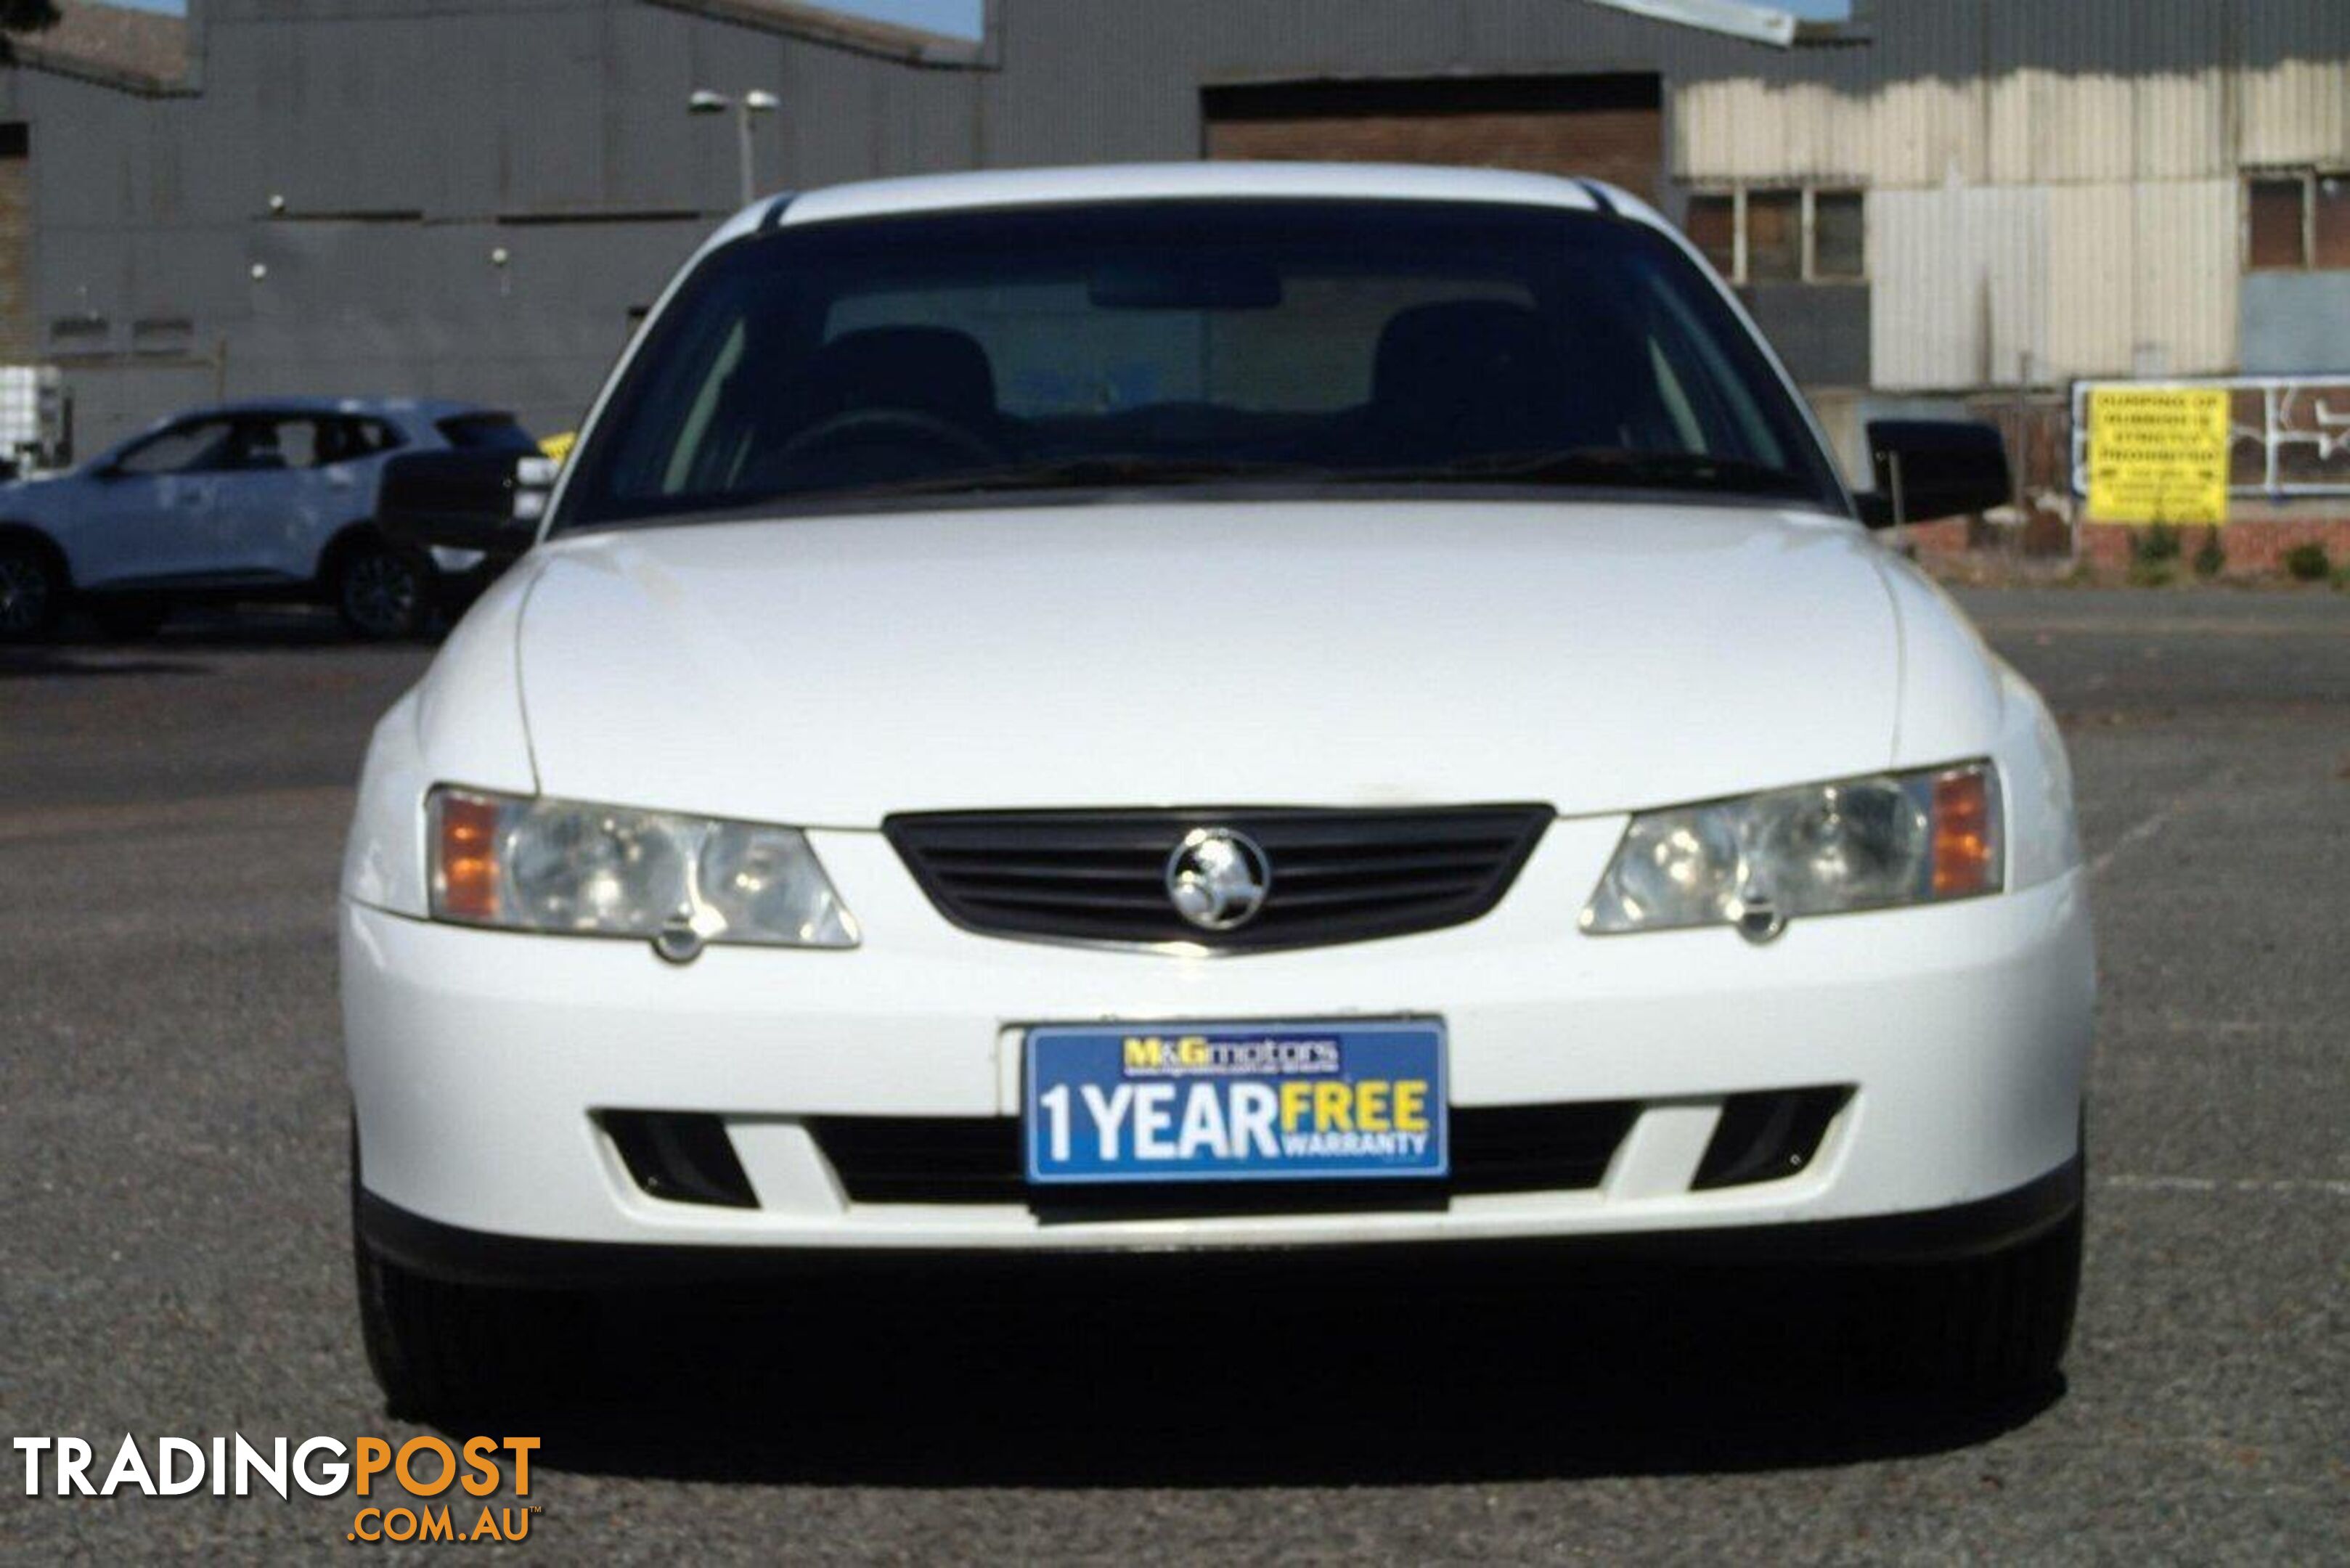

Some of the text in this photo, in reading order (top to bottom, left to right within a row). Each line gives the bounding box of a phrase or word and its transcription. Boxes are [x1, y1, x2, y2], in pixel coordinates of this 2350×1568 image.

[1040, 1080, 1429, 1161] 1 YEAR FREE
[1281, 1132, 1428, 1156] WARRANTY
